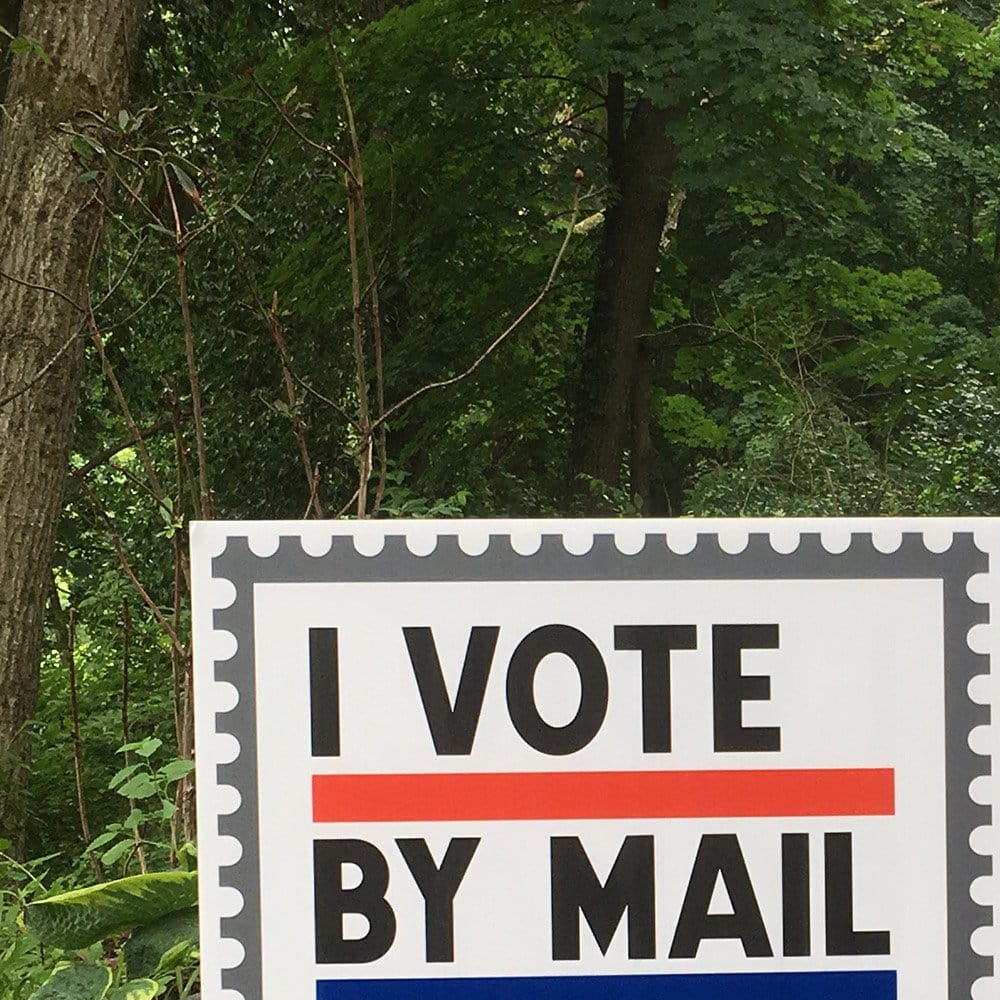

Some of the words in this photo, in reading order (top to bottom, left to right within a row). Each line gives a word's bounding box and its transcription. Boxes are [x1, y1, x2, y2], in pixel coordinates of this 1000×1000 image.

[308, 627, 341, 757] I
[401, 623, 781, 756] VOTE
[312, 837, 482, 965] BY
[550, 831, 891, 961] MAIL
